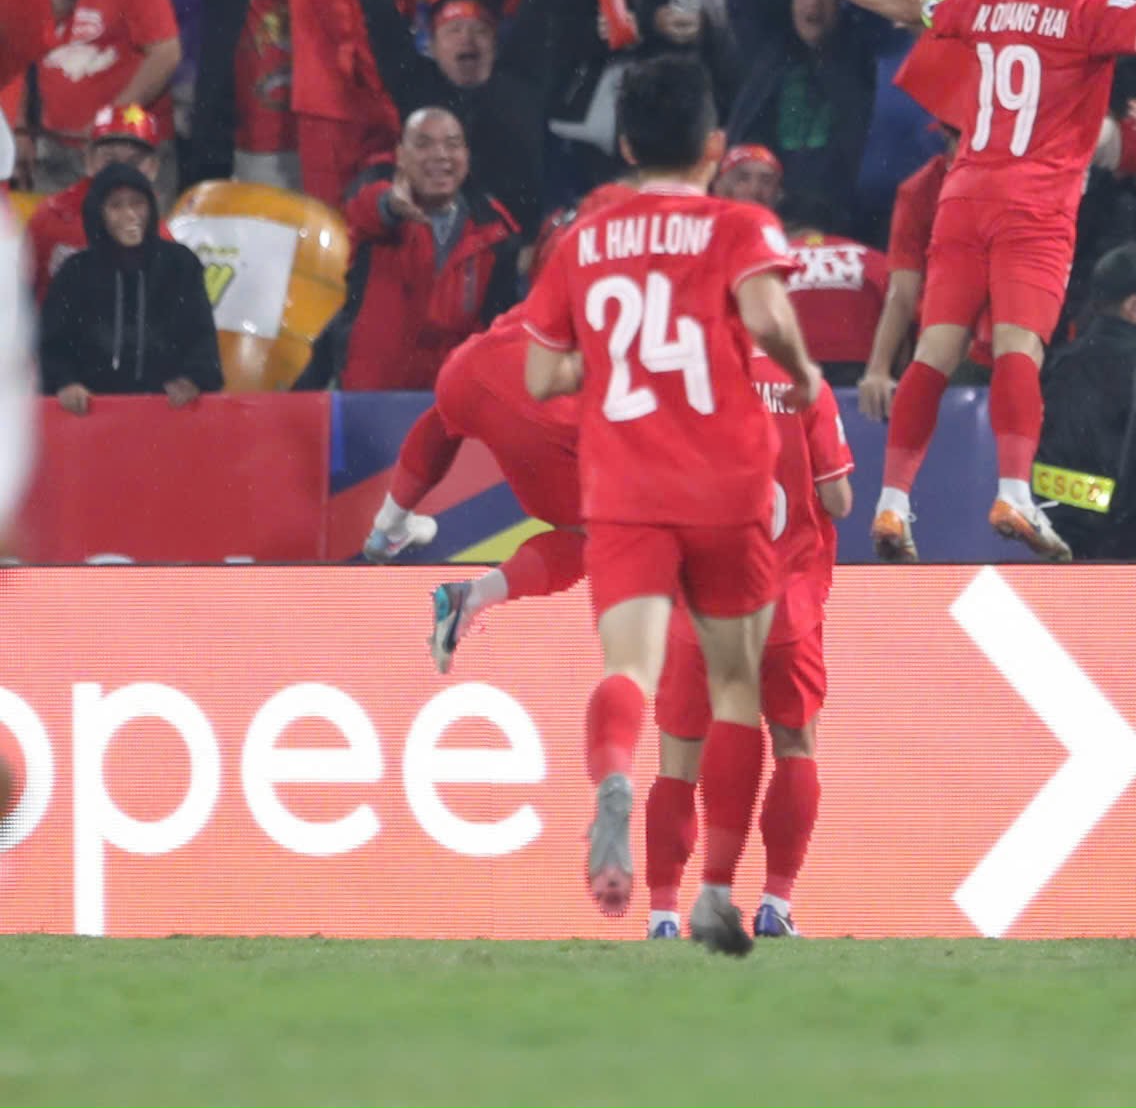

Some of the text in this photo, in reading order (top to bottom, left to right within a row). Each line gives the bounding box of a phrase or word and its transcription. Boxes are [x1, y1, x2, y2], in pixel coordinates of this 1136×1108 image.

[1037, 6, 1070, 39] HAI
[970, 41, 1042, 157] 19
[578, 225, 602, 267] N.
[605, 214, 647, 260] HAI
[585, 271, 715, 423] 24
